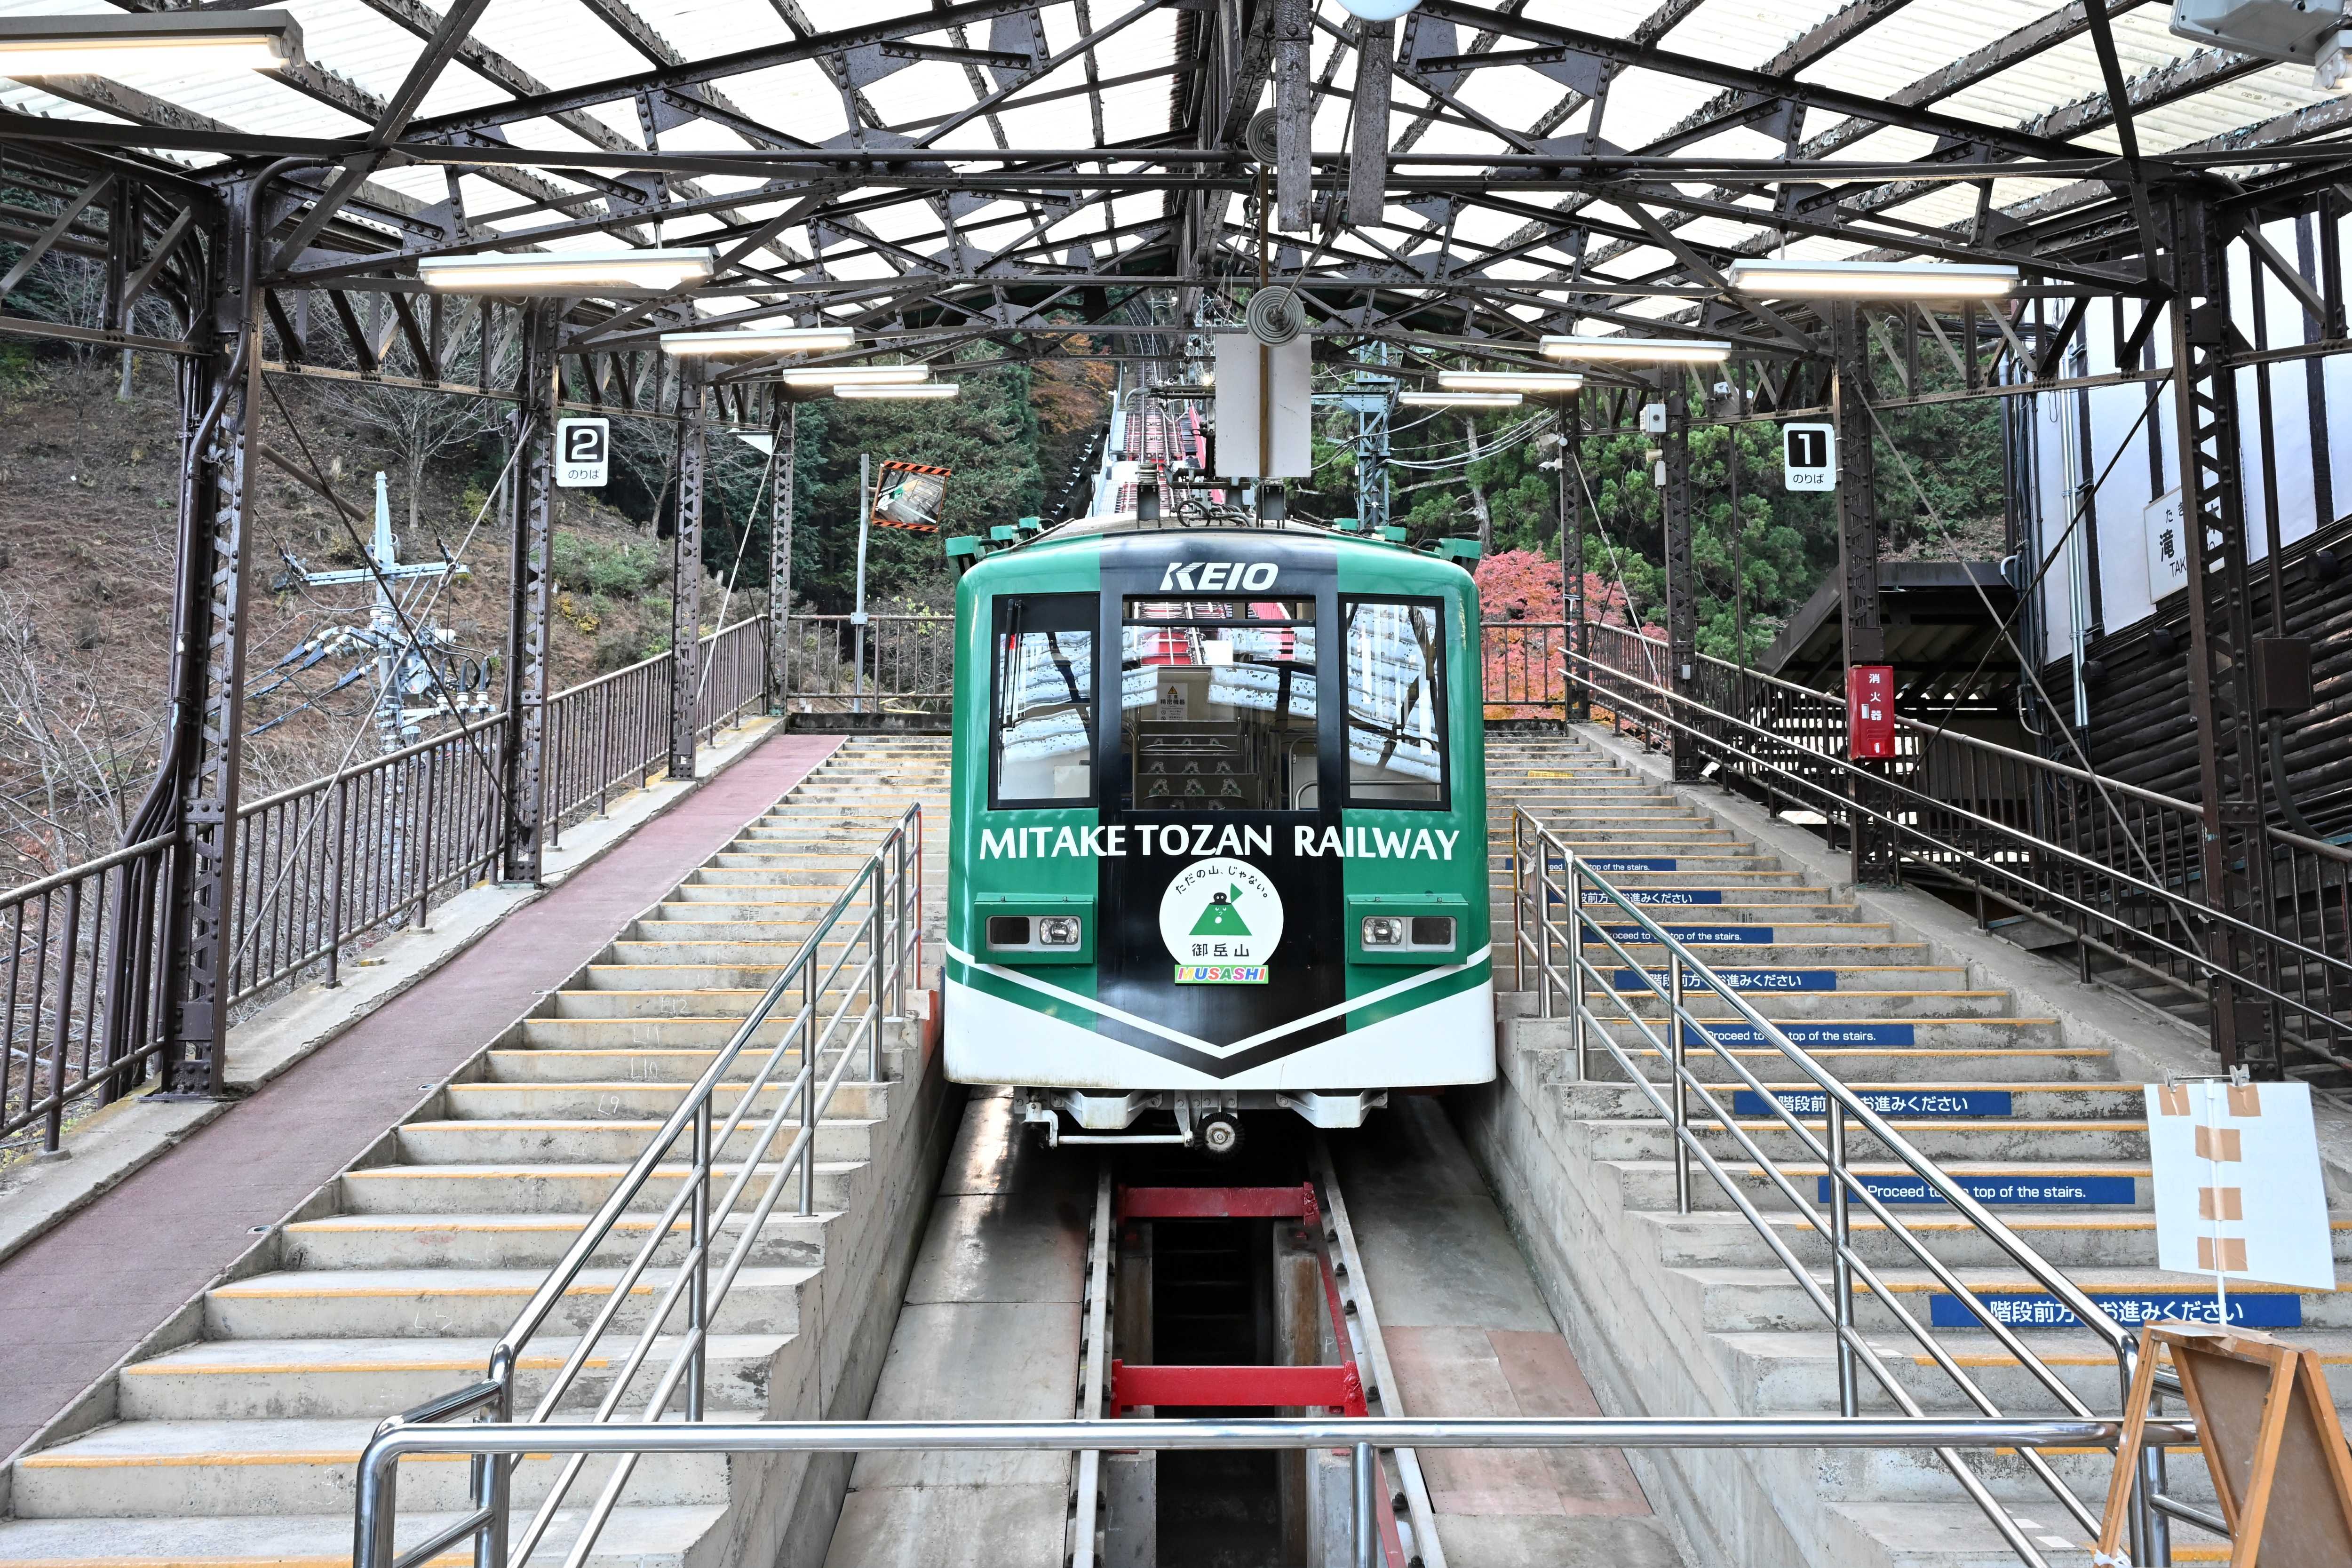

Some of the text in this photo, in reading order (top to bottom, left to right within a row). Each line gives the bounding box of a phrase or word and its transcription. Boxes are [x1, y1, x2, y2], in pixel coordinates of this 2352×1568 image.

[571, 429, 598, 460] 2
[1798, 434, 1811, 464] 1
[568, 470, 601, 479] のりば
[1793, 474, 1824, 484] のりば
[1160, 563, 1278, 590] KEIO
[1868, 673, 1882, 721] 消火器
[980, 824, 1460, 861] MITAKE TOZAN RAILWAY
[1176, 866, 1268, 898] ただの山、じゃない。
[1192, 943, 1249, 957] 御岳山
[1178, 967, 1265, 980] MUSASHI
[1753, 1032, 1764, 1041] to
[1788, 1032, 1805, 1042] top
[1809, 1031, 1819, 1041] of
[1822, 1031, 1839, 1041] the
[1843, 1031, 1876, 1041] stairs.
[1973, 1186, 1995, 1199] top
[2000, 1186, 2013, 1197] of
[2017, 1186, 2040, 1197] the
[2044, 1186, 2086, 1198] stairs.
